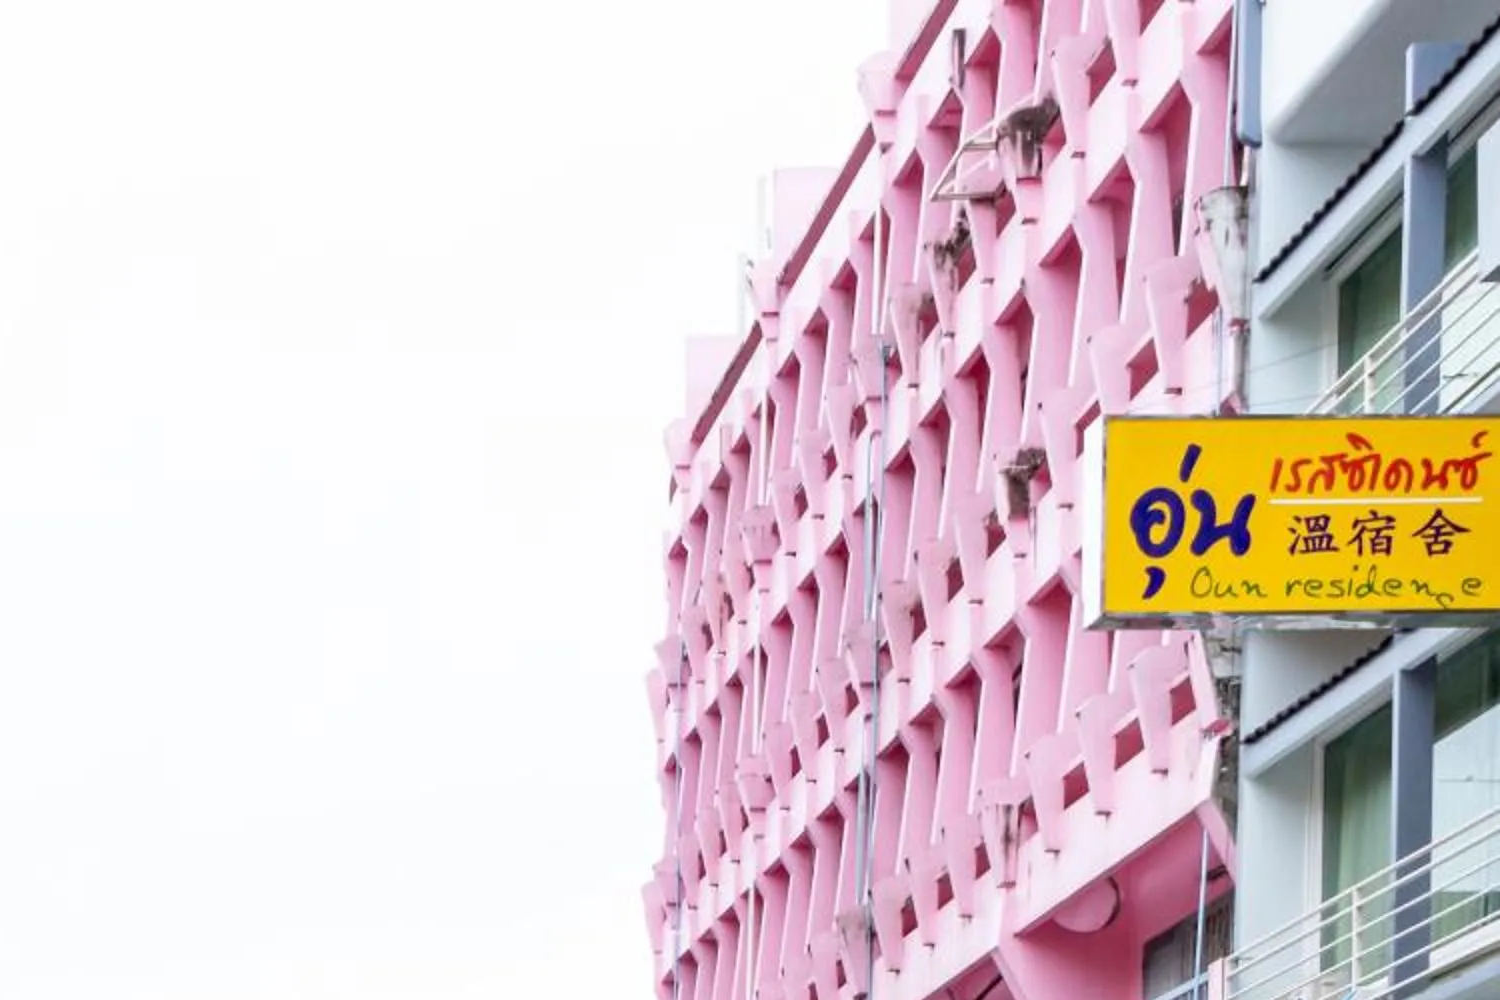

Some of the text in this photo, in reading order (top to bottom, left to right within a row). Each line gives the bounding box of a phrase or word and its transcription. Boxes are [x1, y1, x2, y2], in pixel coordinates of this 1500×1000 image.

[1130, 443, 1257, 600] อุ่น
[1190, 564, 1483, 610] Oun residence
